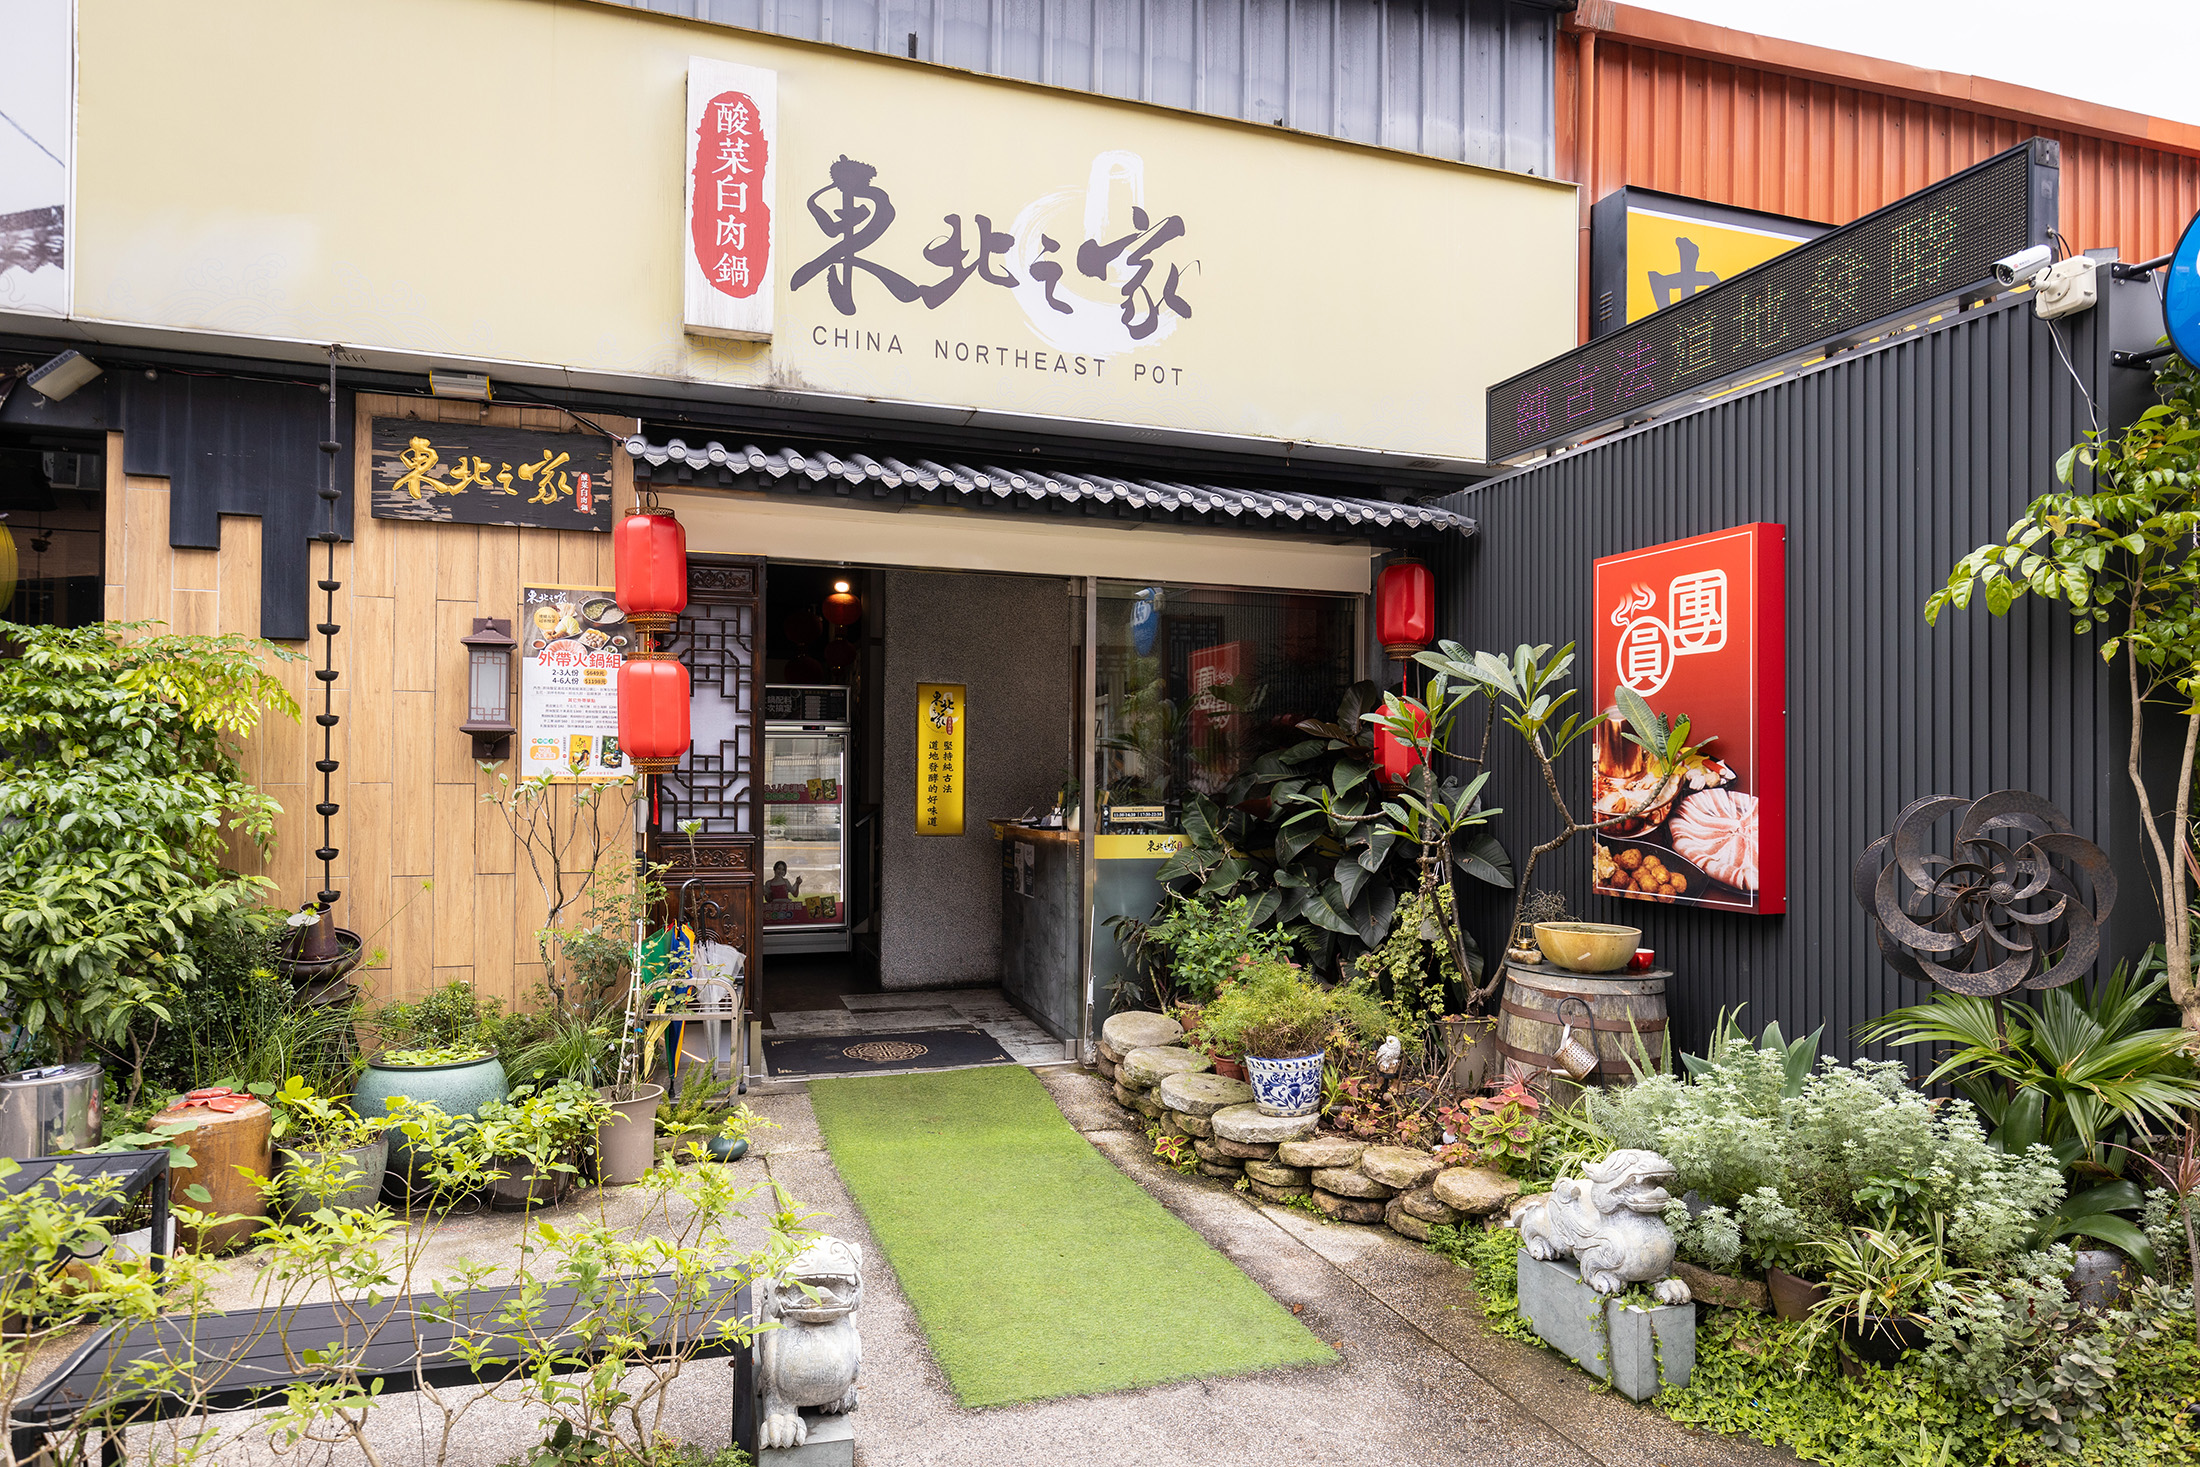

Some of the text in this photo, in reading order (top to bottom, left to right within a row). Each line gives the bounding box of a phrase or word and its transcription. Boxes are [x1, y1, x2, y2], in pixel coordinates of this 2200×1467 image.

[711, 100, 753, 289] 酸菜白肉鍋
[790, 154, 1201, 341] 東北之家
[1516, 205, 1960, 442] 純古法道地發酵
[811, 324, 1184, 387] CHINA NORTHEAST POT
[392, 435, 574, 505] 東北之家
[526, 589, 568, 604] 東北之家
[538, 651, 622, 669] 外帶火鍋組
[764, 696, 792, 704] 鍋配料
[764, 704, 792, 712] 次搞定
[926, 740, 940, 827] 道地發酵的好味道
[942, 740, 953, 794] 堅持純古法
